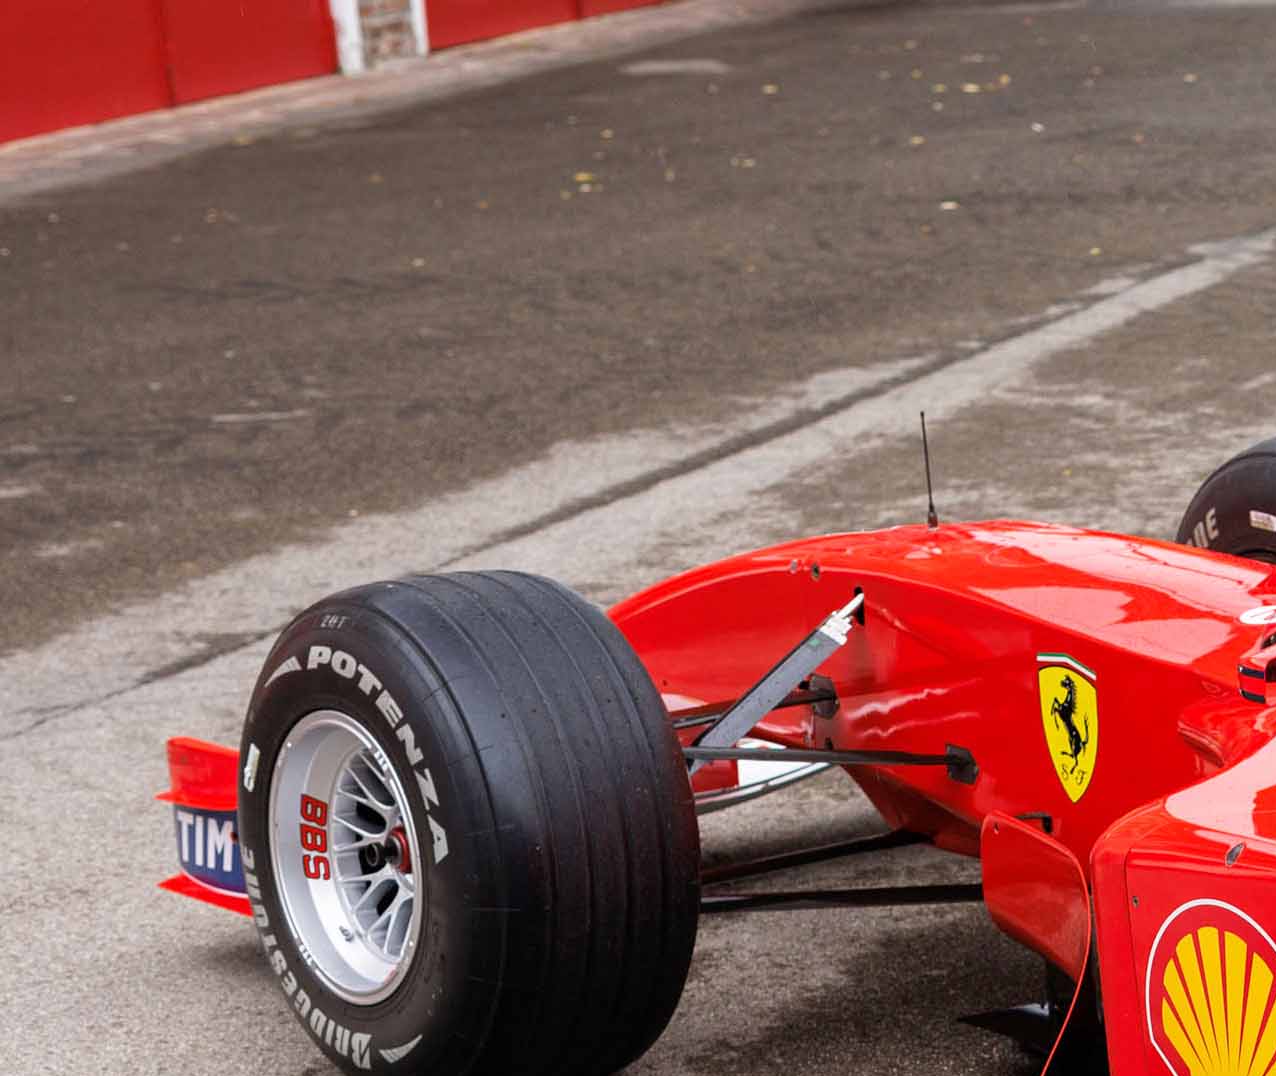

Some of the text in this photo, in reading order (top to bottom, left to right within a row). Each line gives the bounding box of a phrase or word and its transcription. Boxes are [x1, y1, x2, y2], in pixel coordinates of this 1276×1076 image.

[306, 645, 449, 864] POTENZA
[176, 810, 234, 872] TIM
[300, 793, 332, 881] BBS
